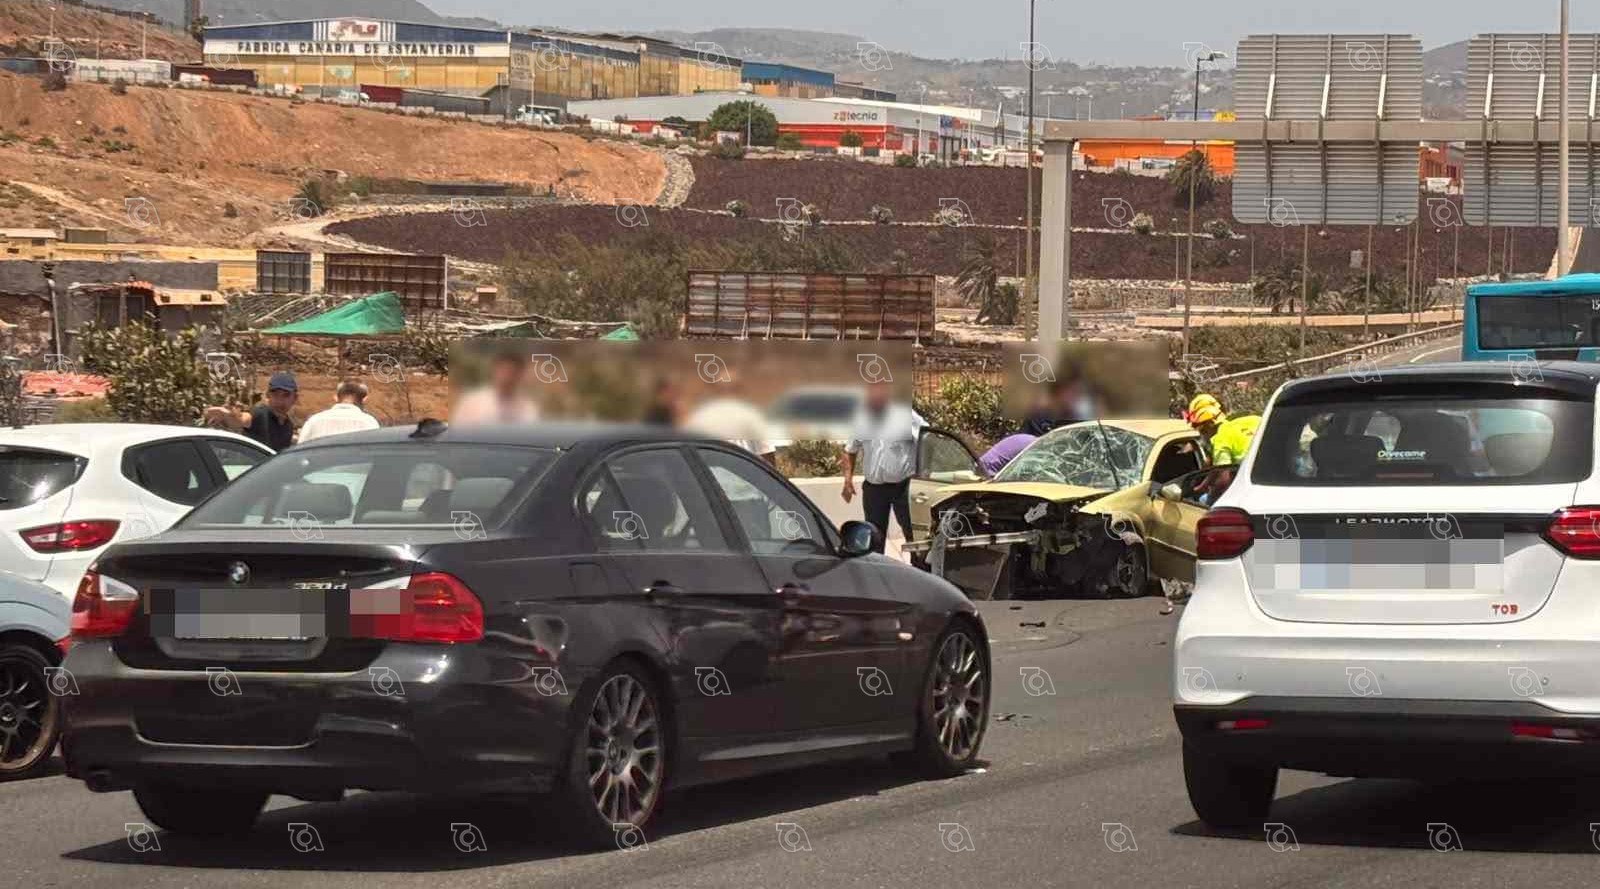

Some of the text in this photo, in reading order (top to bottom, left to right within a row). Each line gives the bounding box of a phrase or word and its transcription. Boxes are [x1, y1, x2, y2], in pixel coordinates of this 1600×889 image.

[237, 41, 475, 56] FABRICA CANARIA DE ESTANTERIAS
